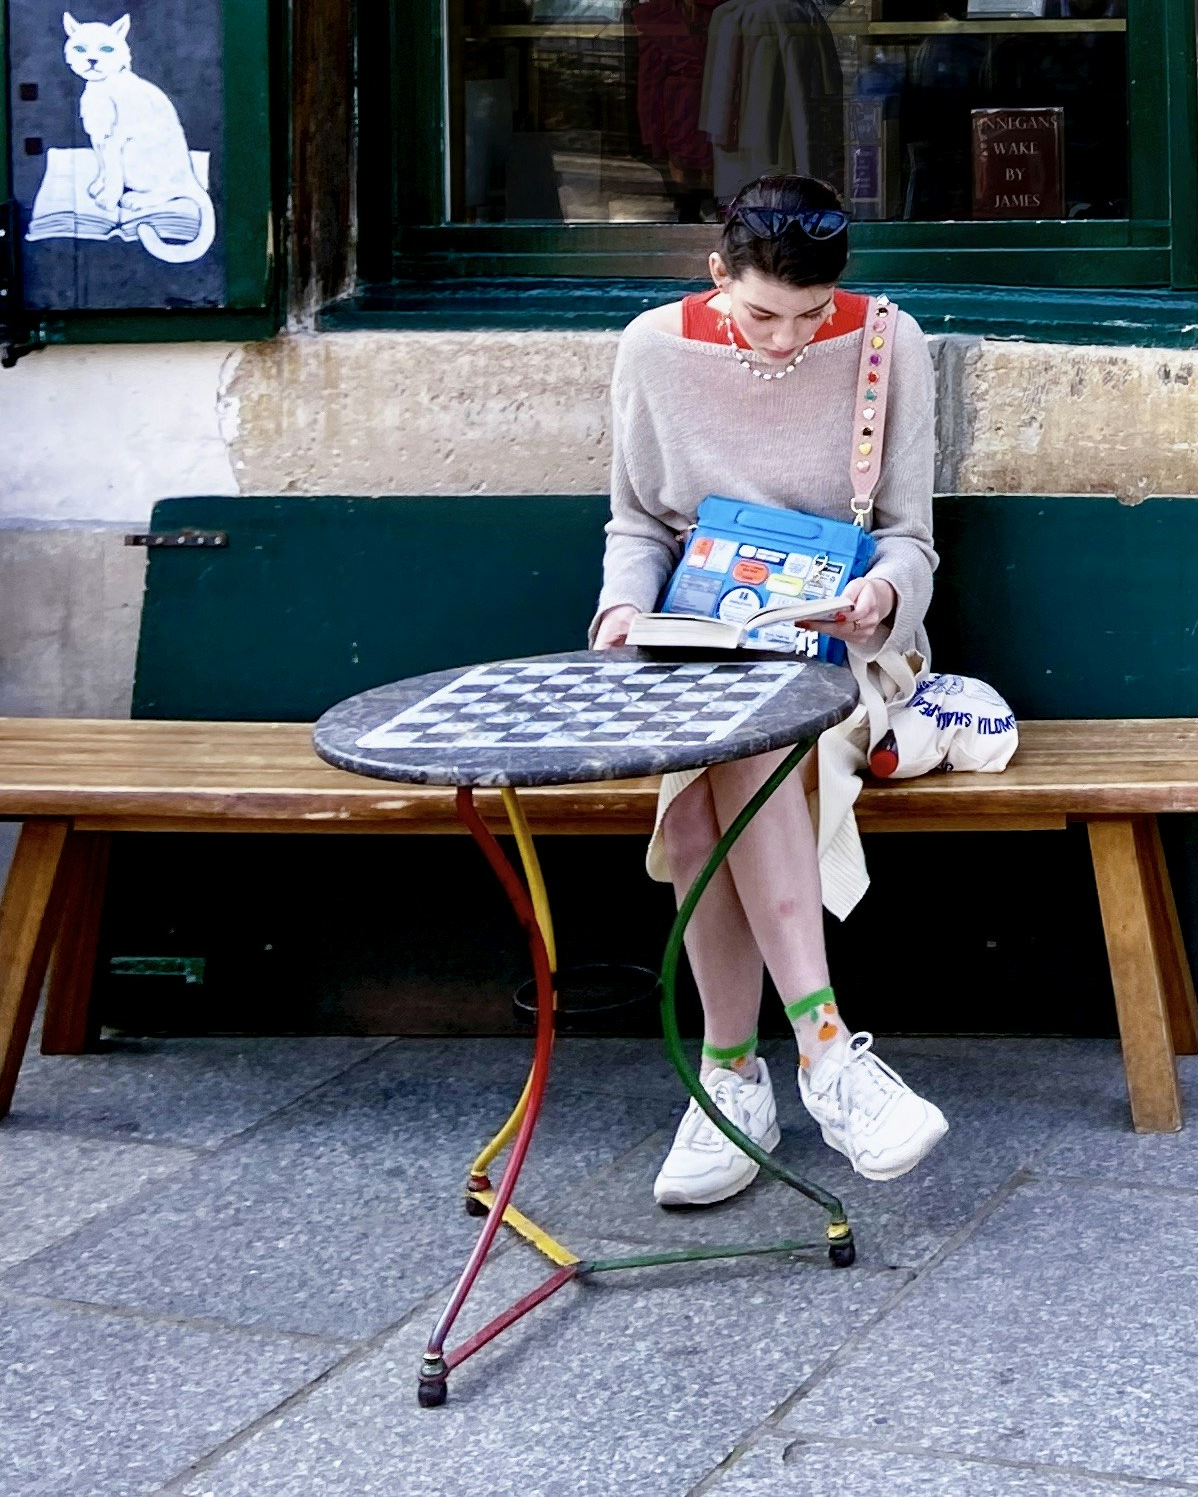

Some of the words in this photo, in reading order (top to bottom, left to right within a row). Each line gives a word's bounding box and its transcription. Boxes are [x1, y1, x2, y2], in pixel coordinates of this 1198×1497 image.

[993, 141, 1041, 156] WAKE
[1005, 166, 1027, 182] BY
[993, 193, 1041, 209] JAMES
